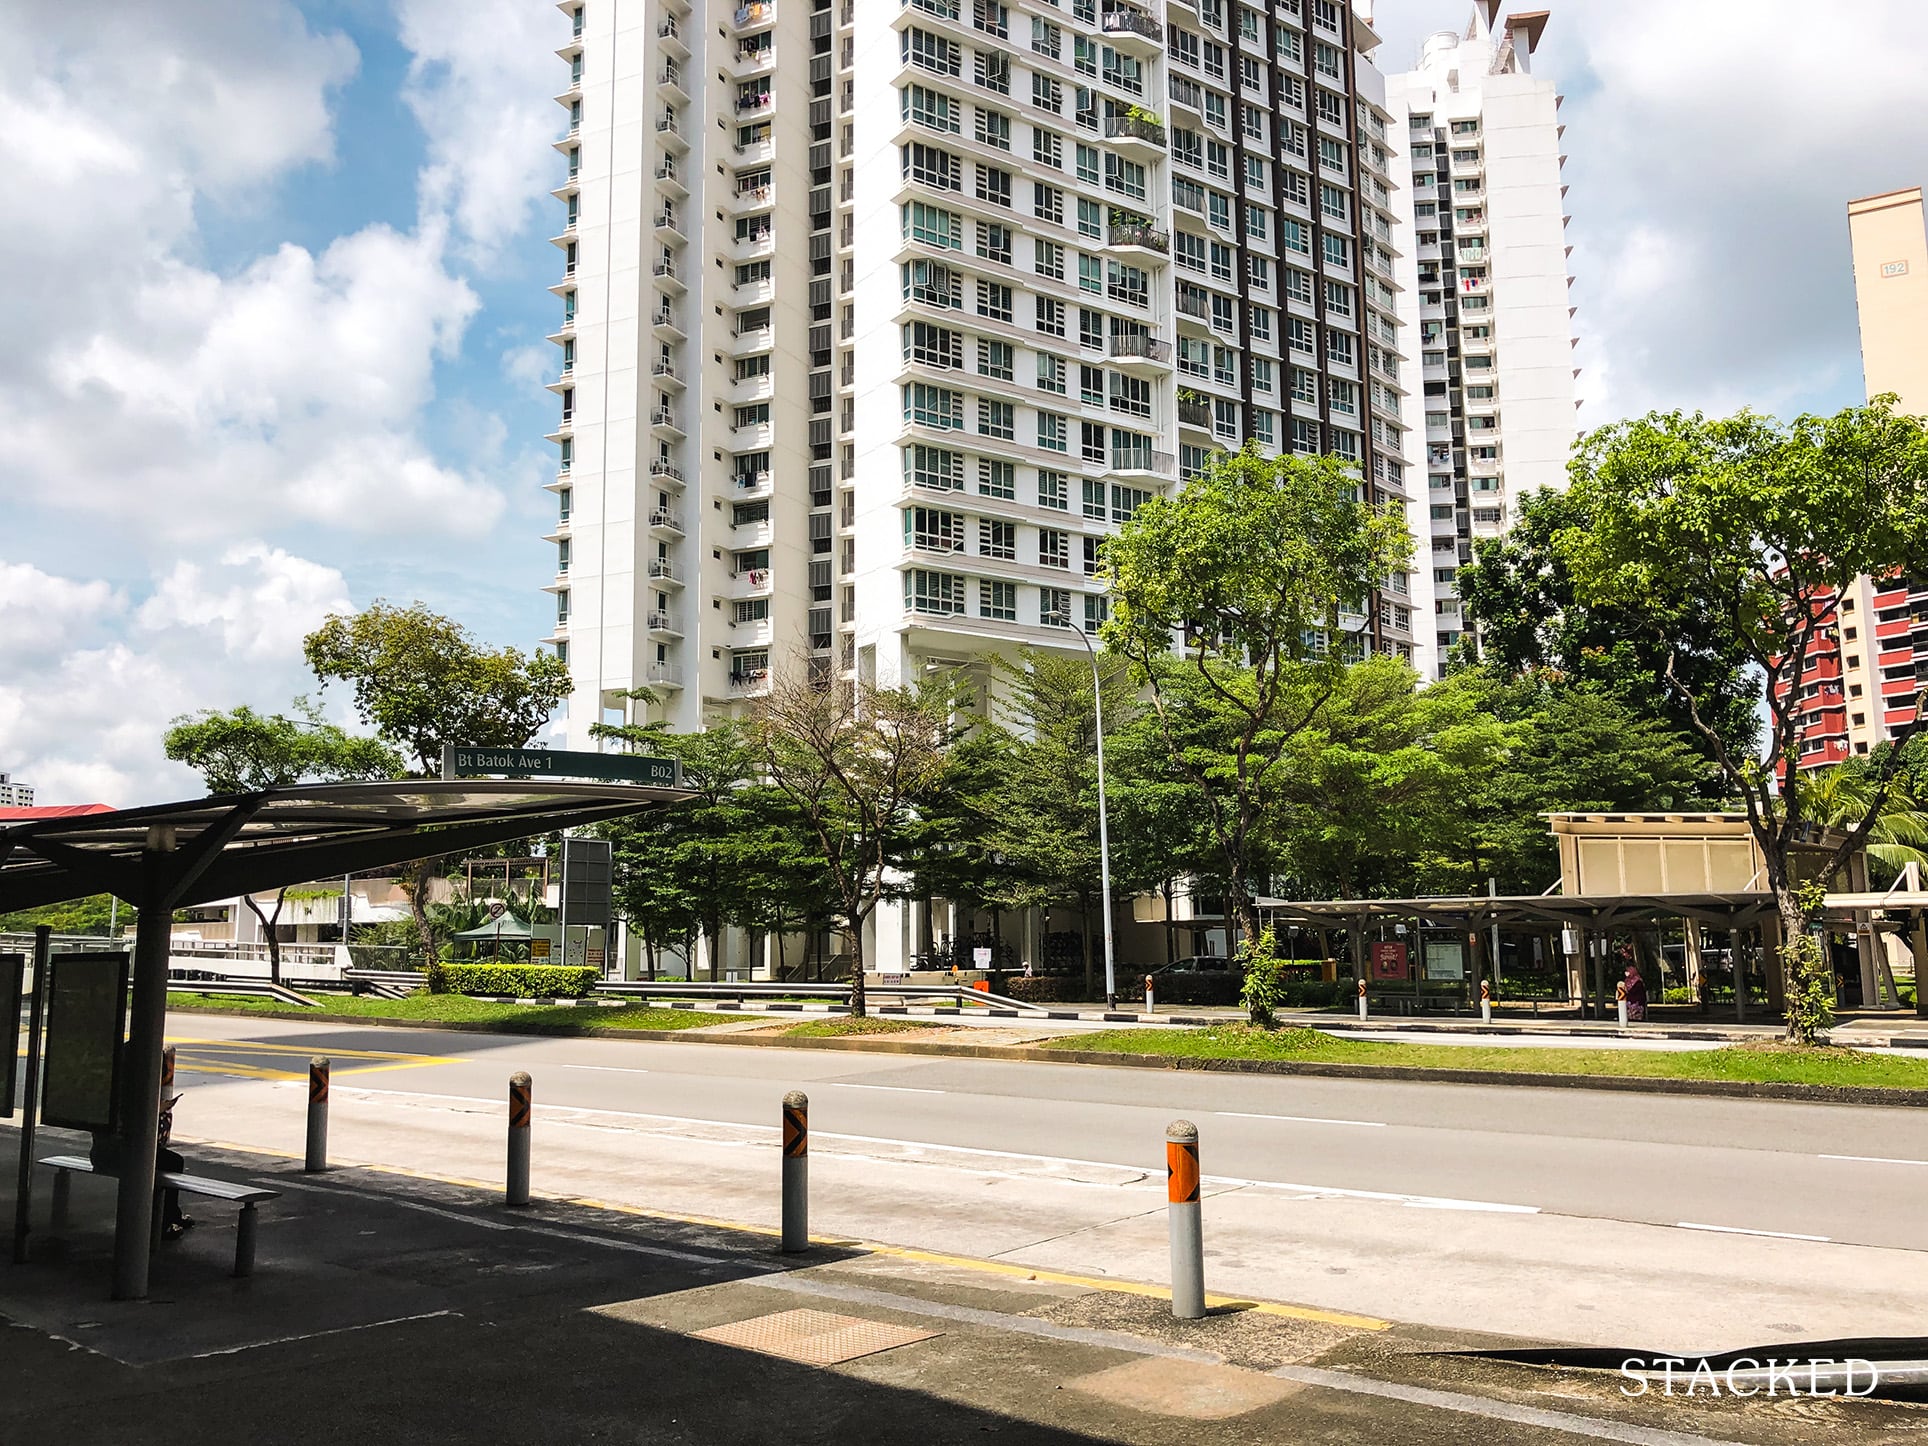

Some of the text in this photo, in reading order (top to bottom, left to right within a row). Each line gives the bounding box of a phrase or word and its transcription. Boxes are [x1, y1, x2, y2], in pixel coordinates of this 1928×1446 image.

[1883, 263, 1905, 275] 192
[458, 753, 553, 769] Bt Batok Ave 1
[651, 764, 673, 779] B02
